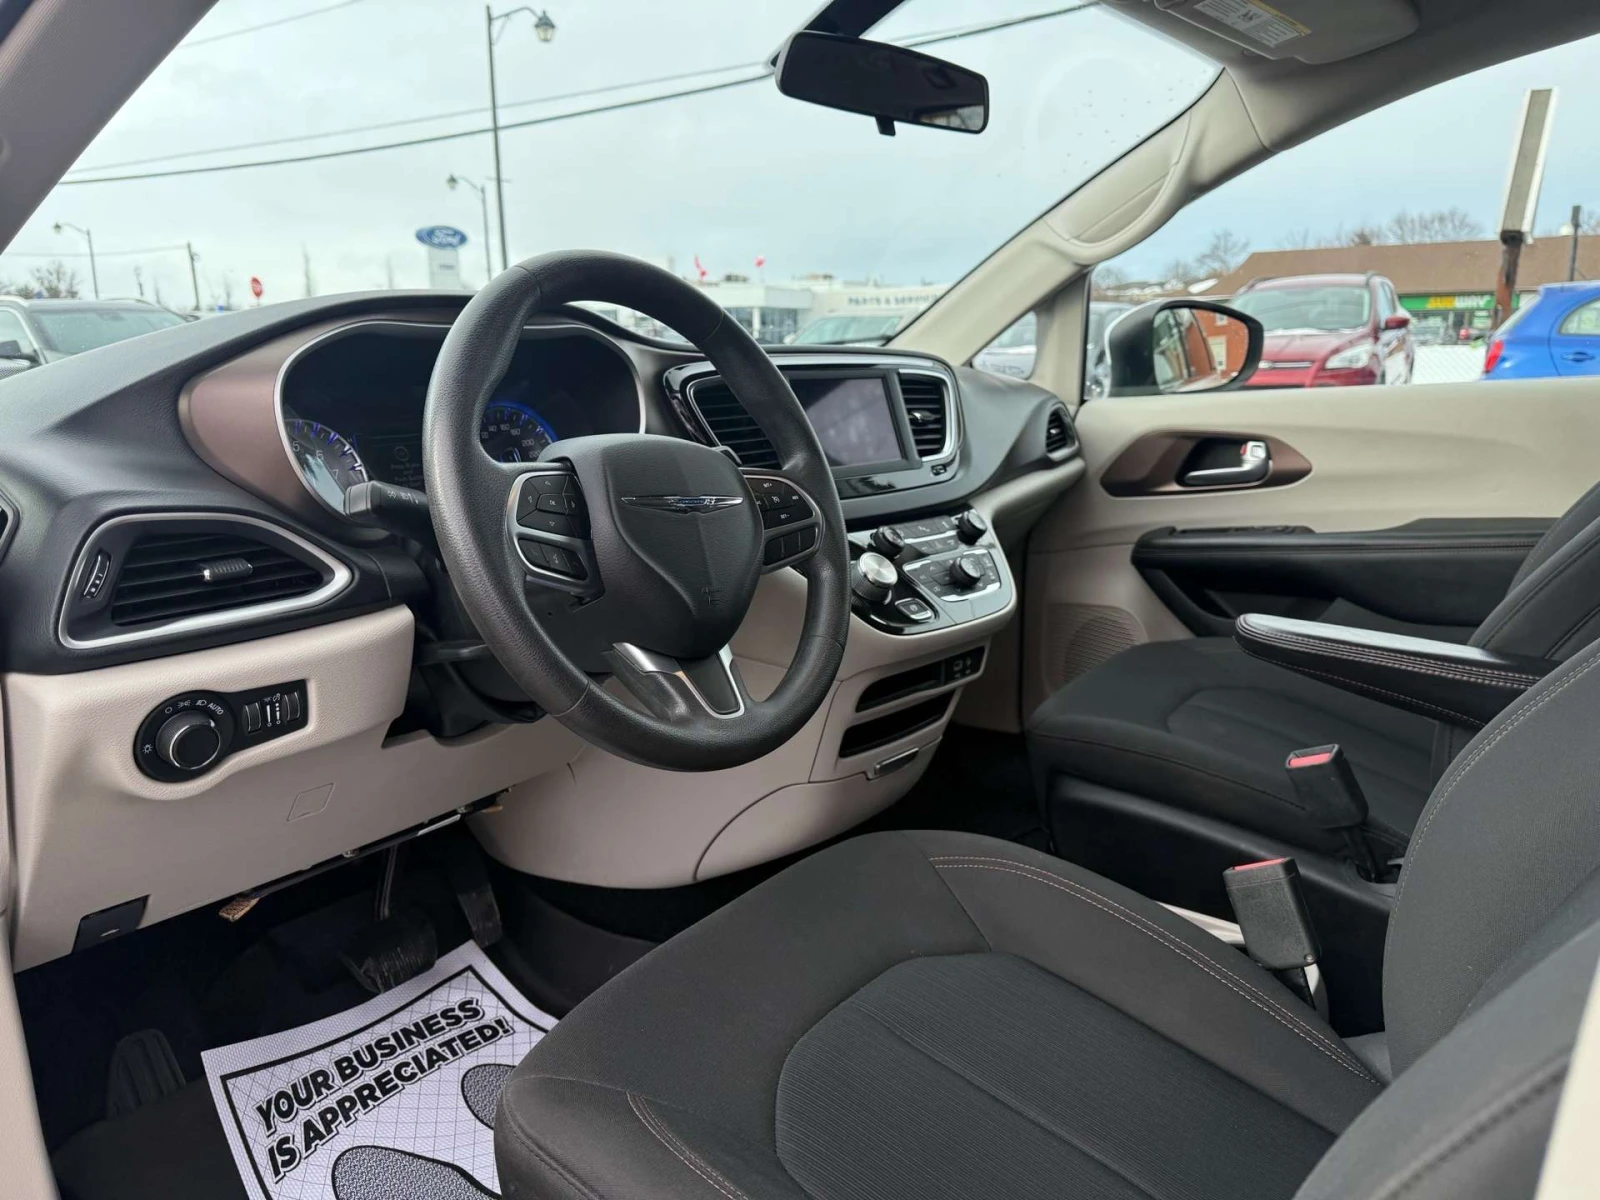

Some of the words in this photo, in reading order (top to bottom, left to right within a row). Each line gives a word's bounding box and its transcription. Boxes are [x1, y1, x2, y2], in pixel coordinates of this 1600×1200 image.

[431, 229, 461, 246] Ford
[292, 440, 300, 452] 5
[208, 702, 224, 715] AUTO
[255, 1069, 334, 1133] YOUR
[334, 998, 484, 1082] BUSINESS
[265, 1136, 300, 1180] IS
[302, 1018, 513, 1154] APPRECIATED!
